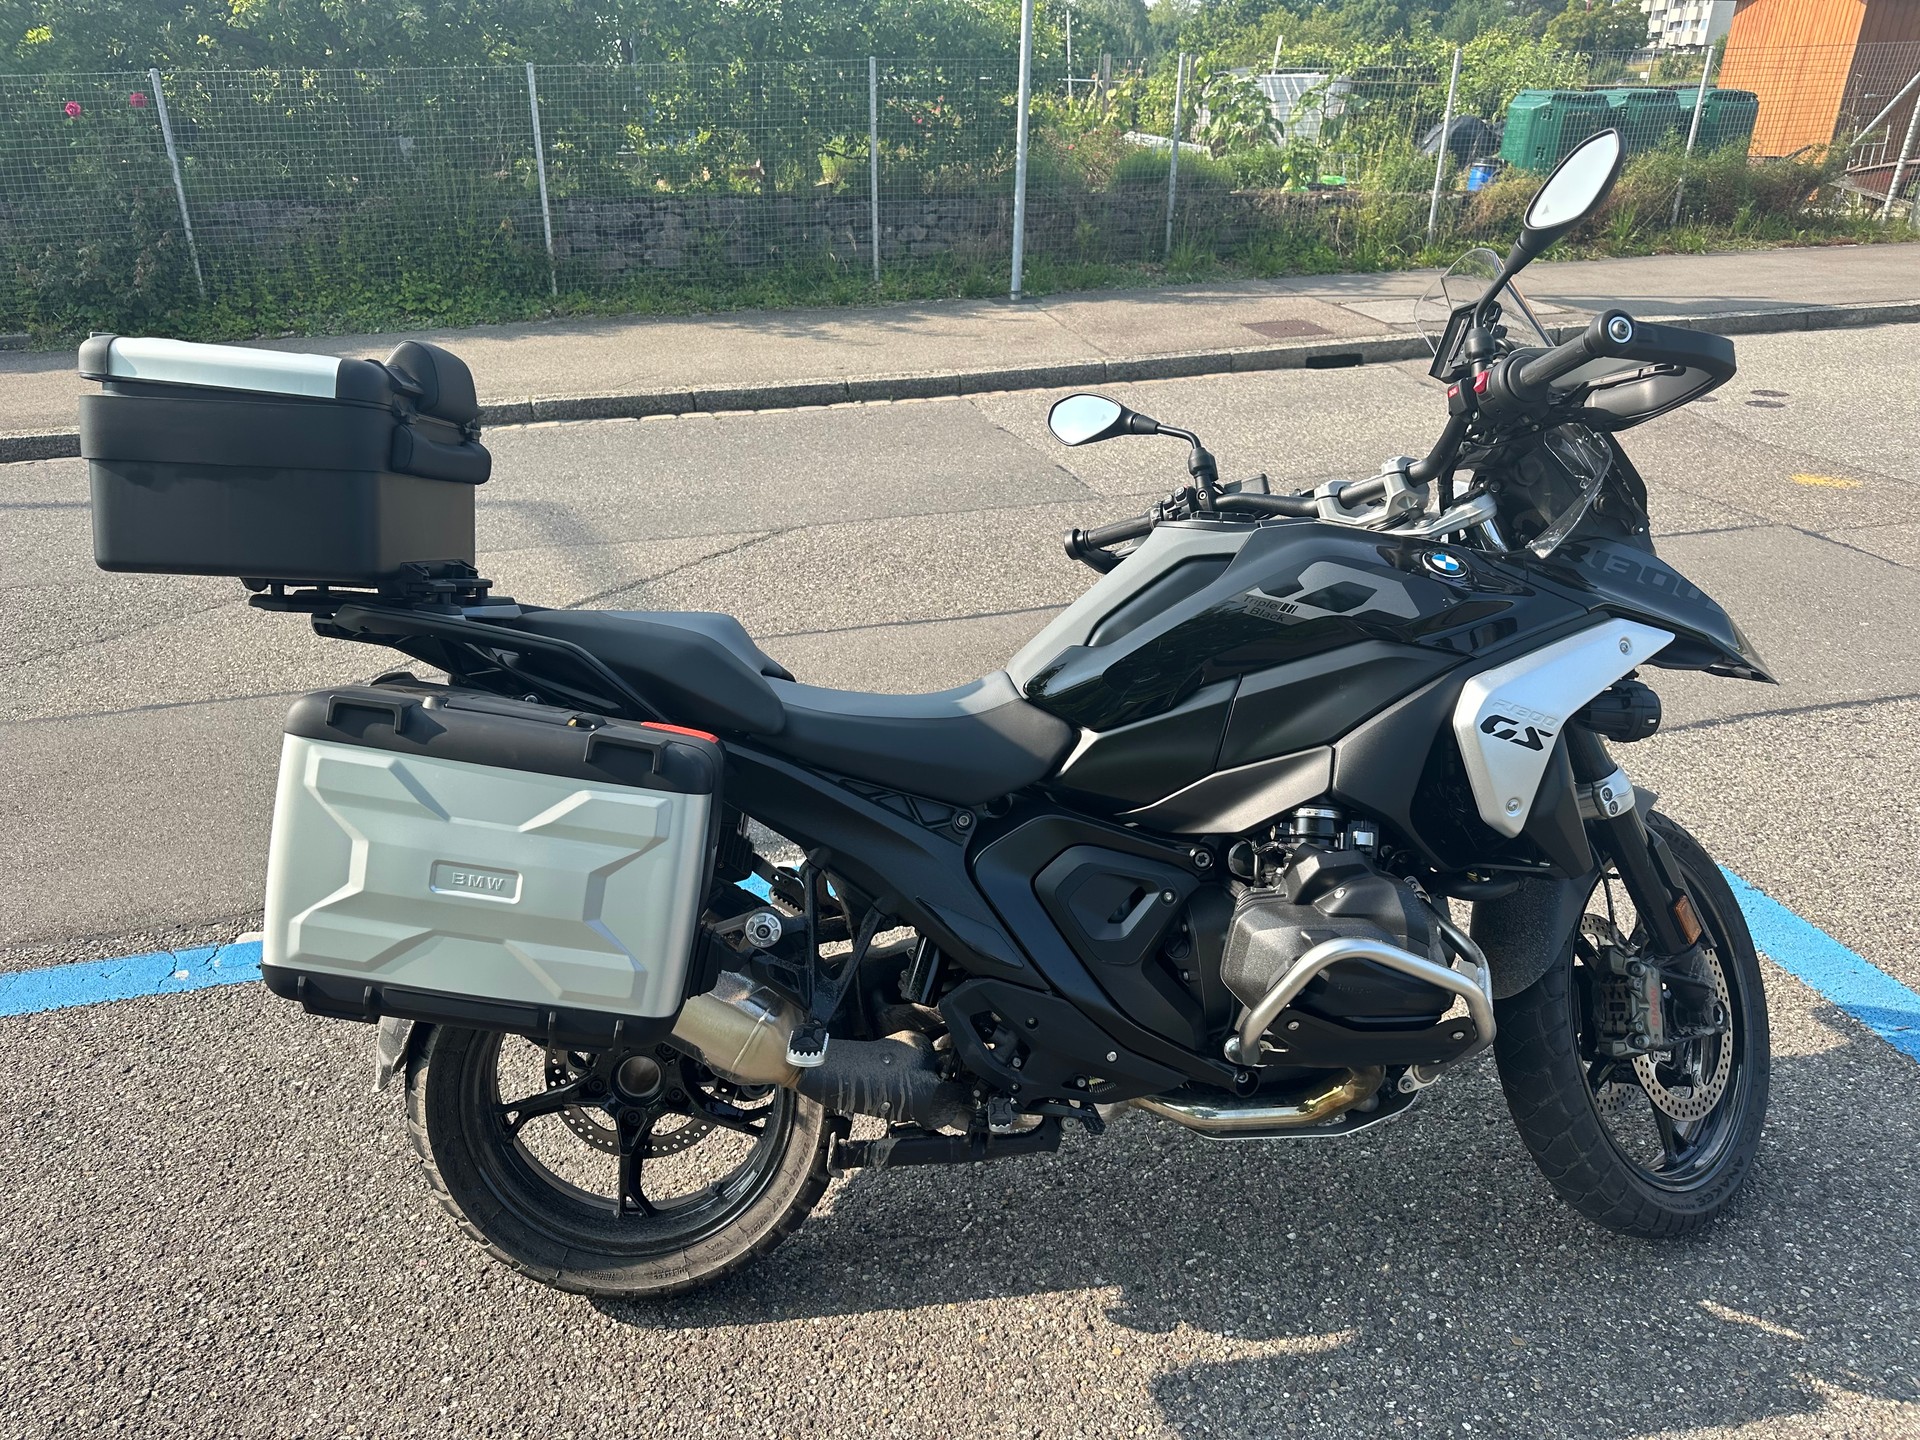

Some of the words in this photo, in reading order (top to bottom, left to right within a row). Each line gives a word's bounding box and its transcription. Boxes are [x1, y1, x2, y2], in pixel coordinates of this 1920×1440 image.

[1242, 594, 1277, 610] Triple
[1250, 607, 1286, 623] Black
[1491, 698, 1559, 729] R1300
[1479, 714, 1555, 751] GS
[451, 871, 505, 892] BMW
[1651, 986, 1659, 1026] BMW
[1695, 1155, 1744, 1207] ANAKEE
